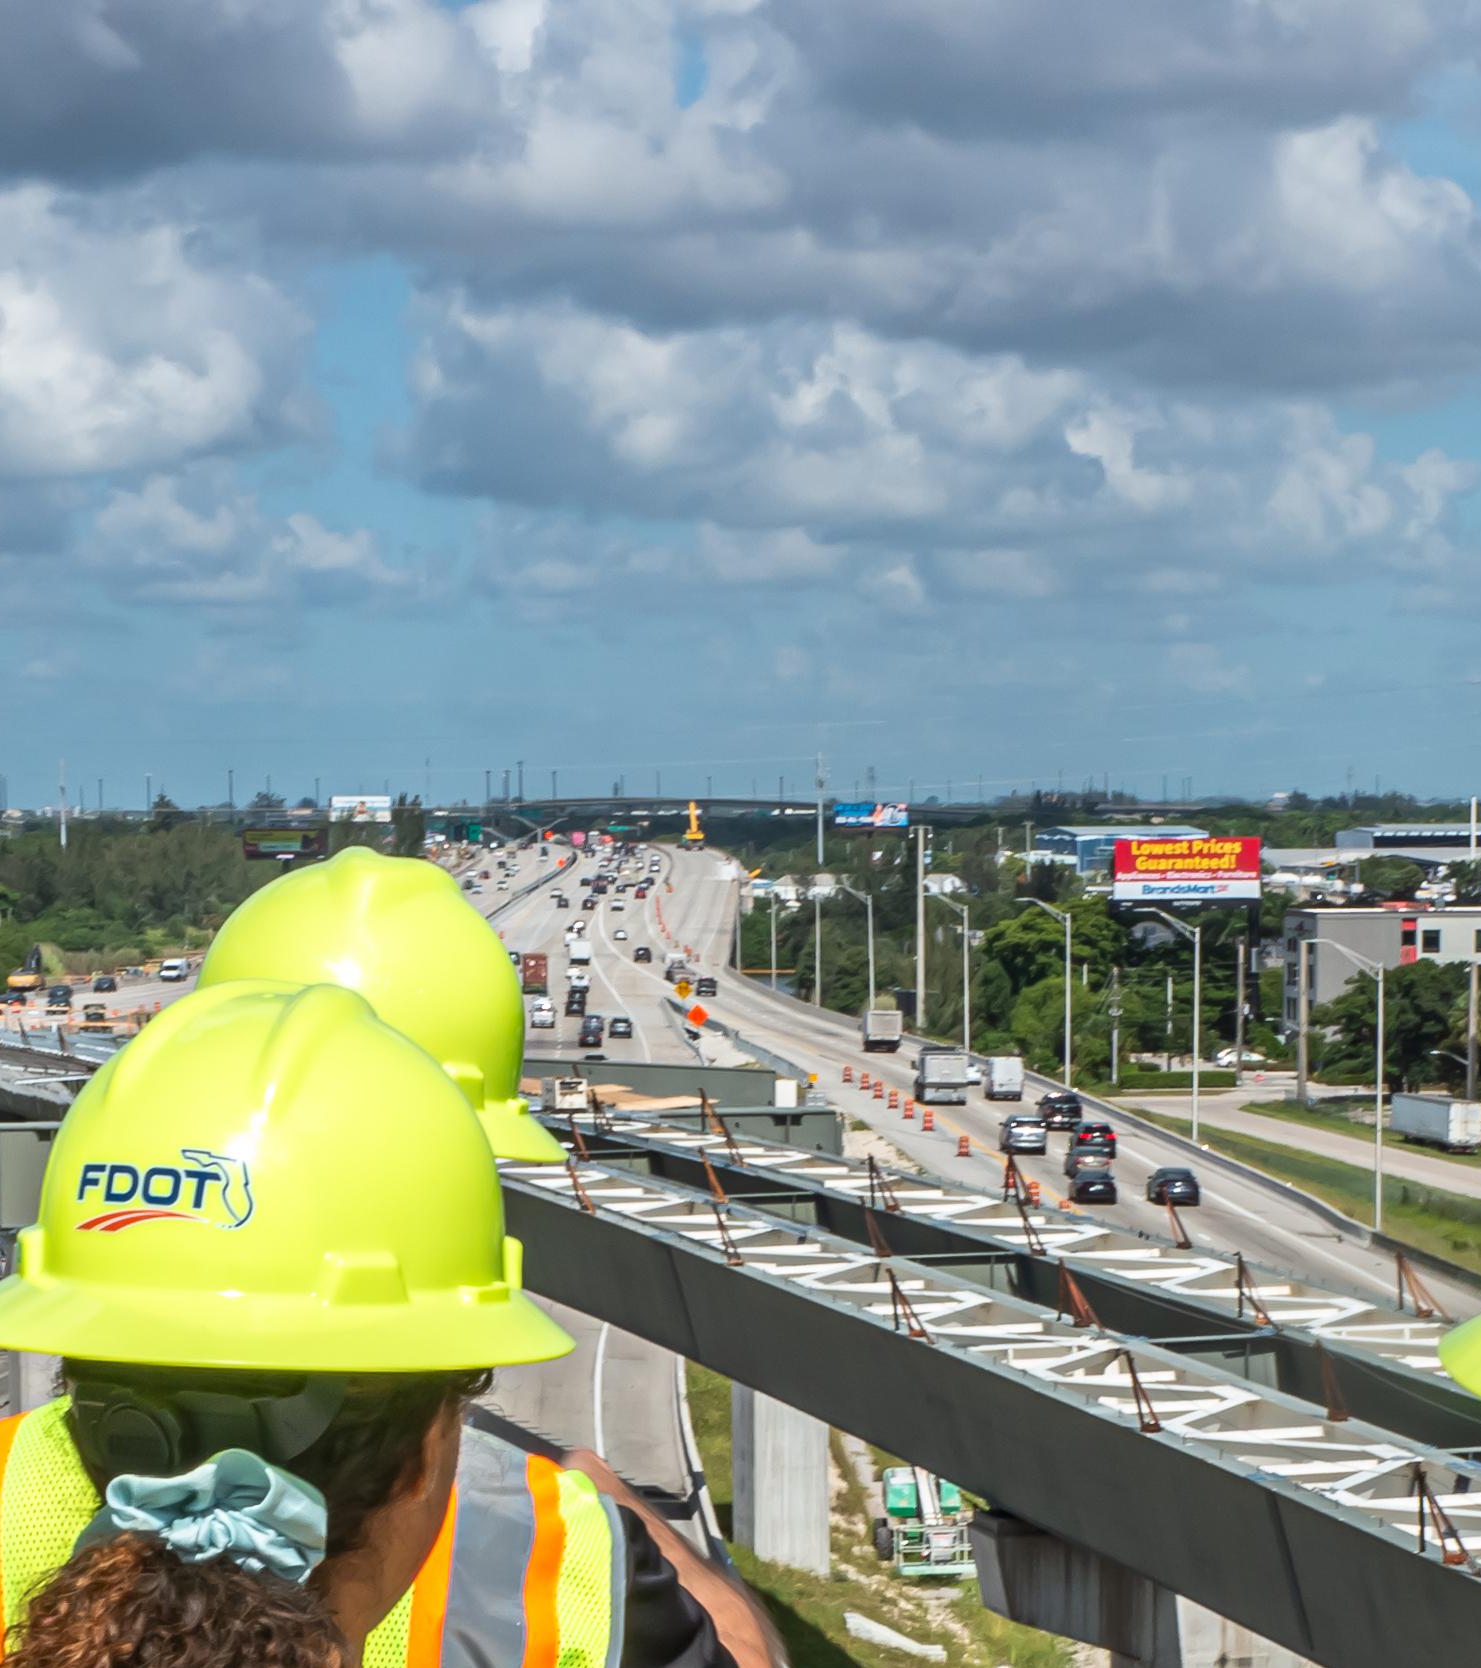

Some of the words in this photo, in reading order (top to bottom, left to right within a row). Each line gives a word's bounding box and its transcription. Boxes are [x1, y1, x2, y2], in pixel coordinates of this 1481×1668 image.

[1131, 841, 1189, 855] Lowest
[1192, 839, 1242, 854] Prices
[1135, 855, 1237, 870] Guaranteed!
[77, 1164, 222, 1209] FDOT
